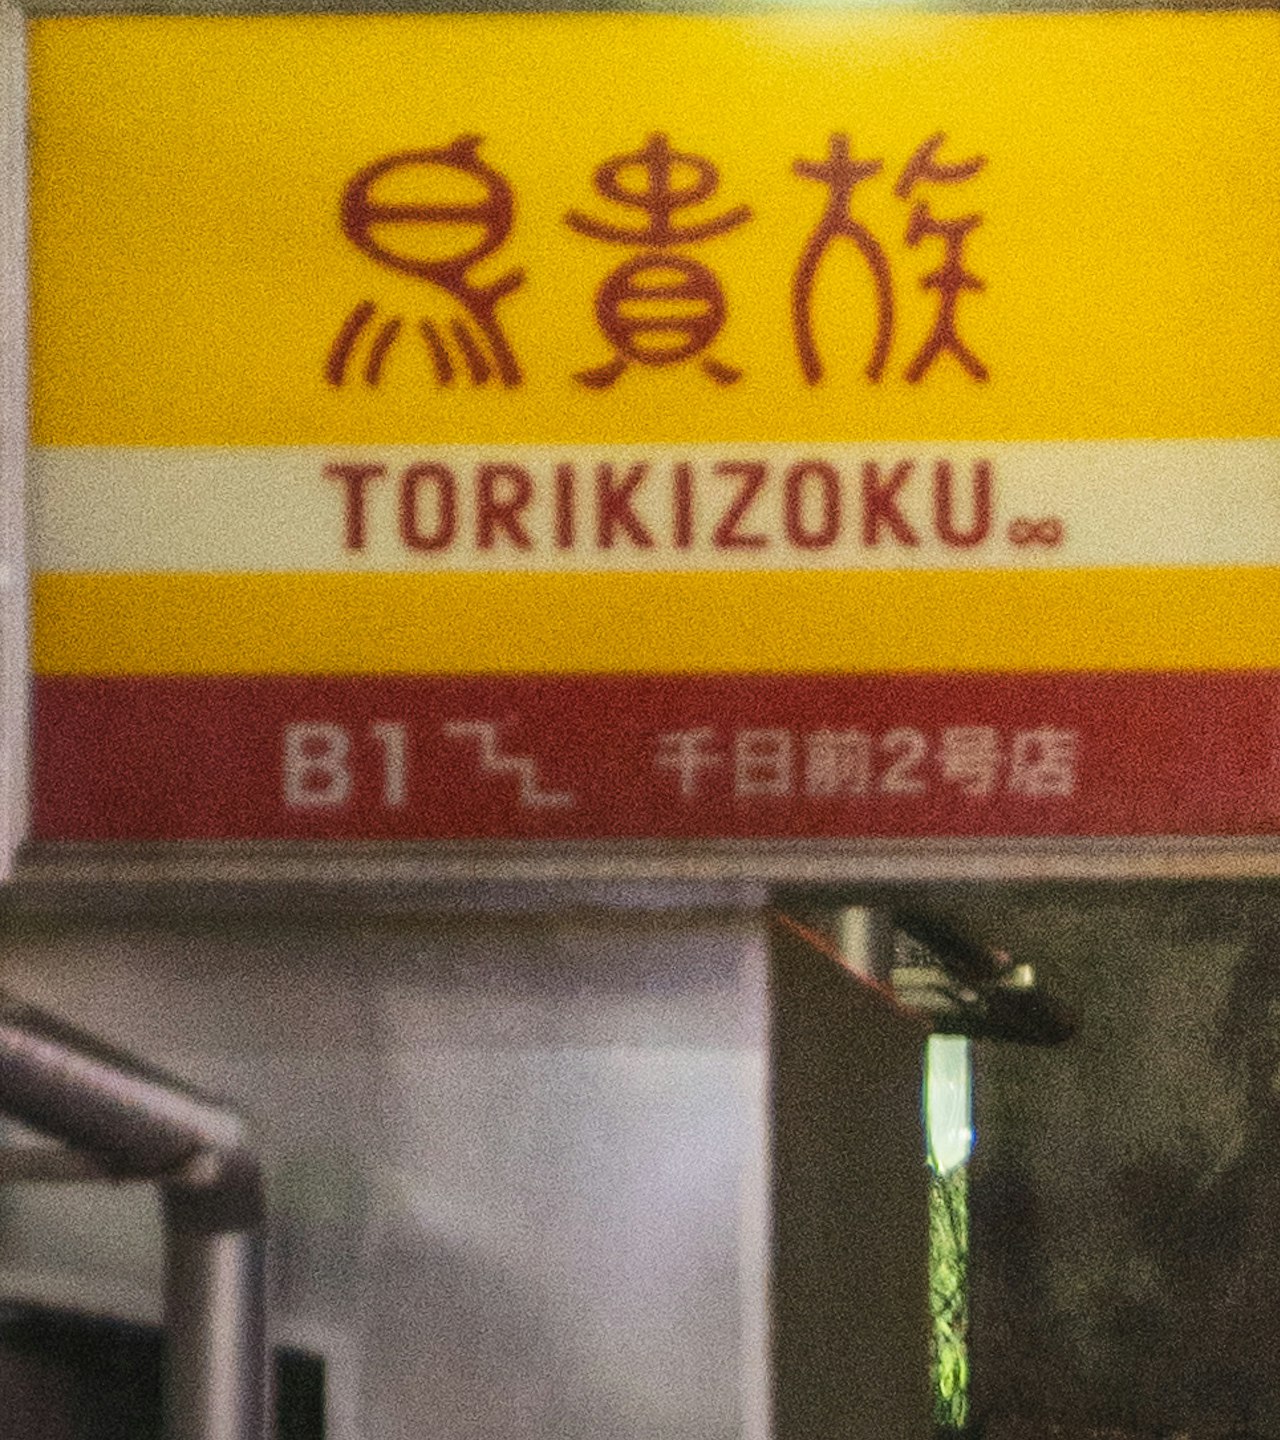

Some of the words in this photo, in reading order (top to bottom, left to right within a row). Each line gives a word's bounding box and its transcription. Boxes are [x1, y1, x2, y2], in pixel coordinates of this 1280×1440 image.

[324, 131, 992, 391] 鳥貴族
[323, 460, 997, 553] TORIKIZOKU
[282, 721, 405, 811] B1
[653, 727, 1077, 800] 千日前2号店
